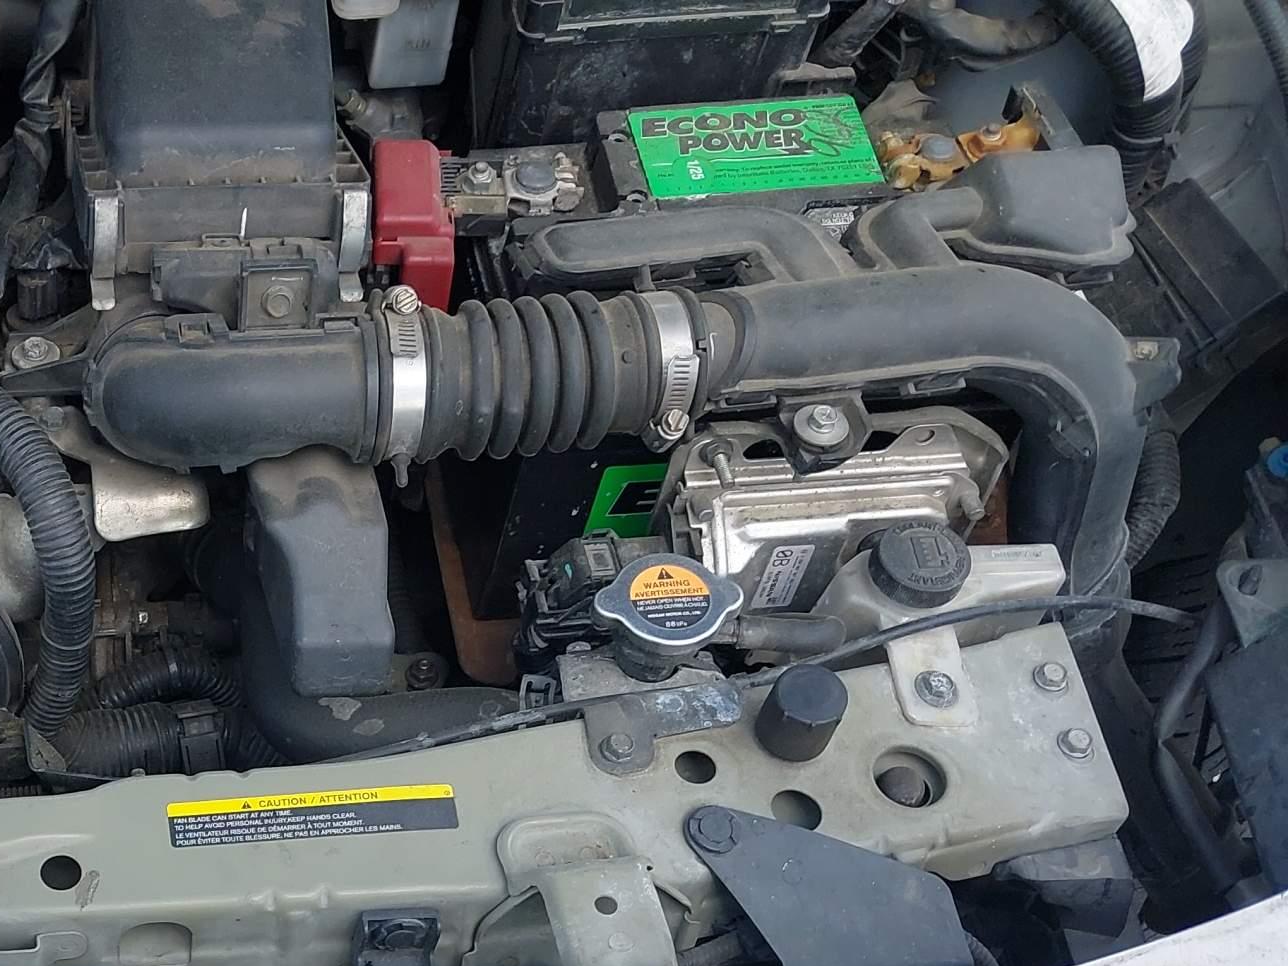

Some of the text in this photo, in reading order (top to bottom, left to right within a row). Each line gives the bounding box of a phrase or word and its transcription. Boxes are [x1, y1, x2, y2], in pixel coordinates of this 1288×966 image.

[640, 108, 809, 138] ECONO
[678, 128, 811, 157] POWER
[686, 160, 705, 180] 1/25
[634, 587, 705, 599] AVERTISSEMENT
[642, 579, 691, 590] WARNING
[258, 797, 307, 808] CAUTION
[319, 791, 378, 804] ATTENTION
[226, 819, 264, 828] PERSONAL
[306, 813, 331, 821] HANDS
[228, 812, 249, 820] START
[185, 830, 228, 838] VENTILATEUR
[230, 827, 257, 835] RISQUE
[257, 826, 268, 834] DE
[313, 821, 332, 829] TOUT
[198, 837, 221, 845] ÉVITER
[320, 826, 364, 836] APPROCHER
